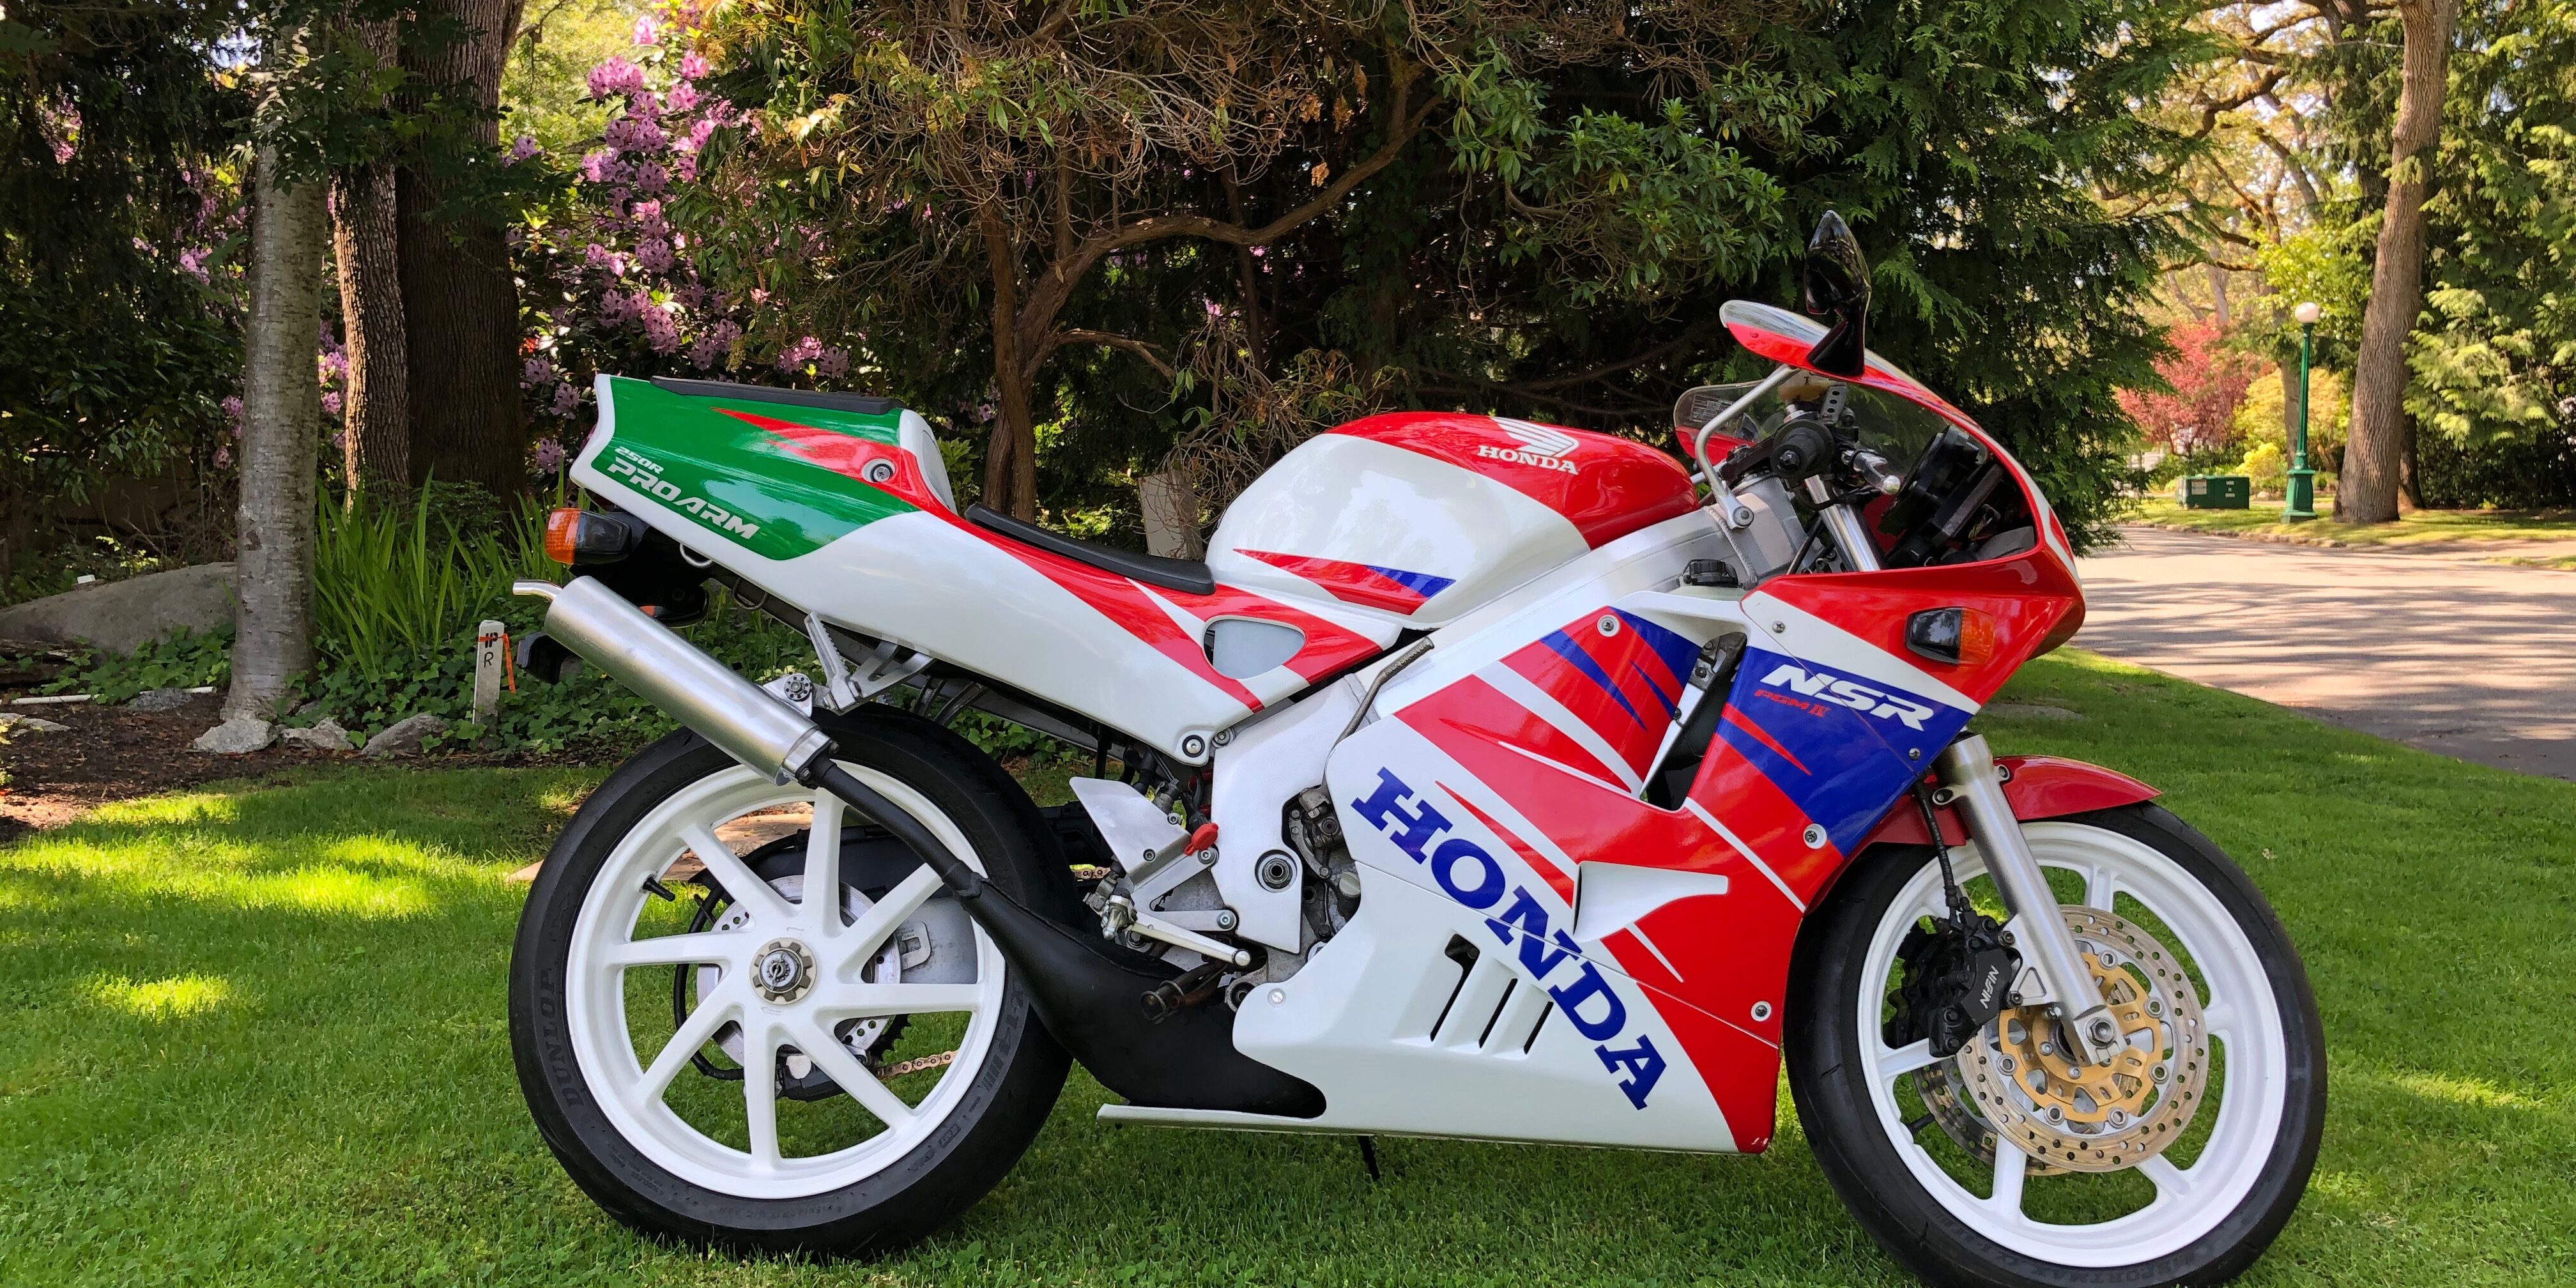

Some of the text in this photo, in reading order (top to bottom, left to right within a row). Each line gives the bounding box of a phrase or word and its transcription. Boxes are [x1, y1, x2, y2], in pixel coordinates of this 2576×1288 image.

[614, 446, 664, 474] 250R
[1476, 445, 1579, 475] HONDA
[484, 652, 494, 668] R
[1759, 664, 1935, 732] NSR
[1351, 766, 1667, 1111] HONDA
[540, 969, 585, 1107] DUNLOP
